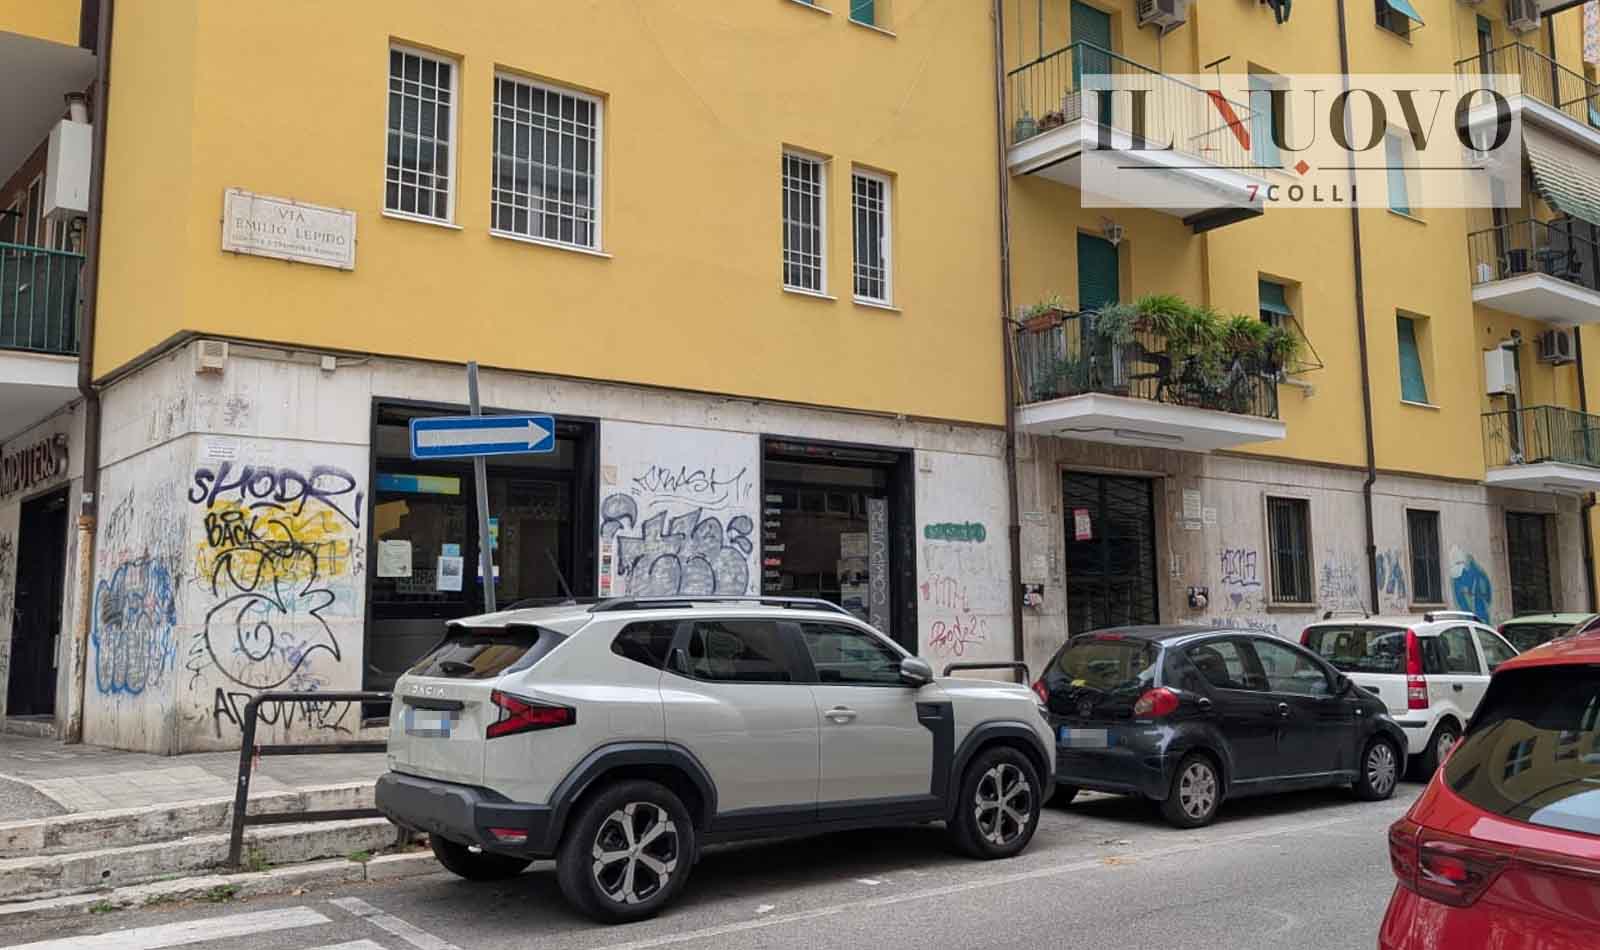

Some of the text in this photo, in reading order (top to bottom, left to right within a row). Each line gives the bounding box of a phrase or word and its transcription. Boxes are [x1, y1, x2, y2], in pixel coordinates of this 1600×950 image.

[278, 206, 305, 223] VIA
[235, 217, 287, 235] EMILIO
[295, 228, 345, 246] LEPIDO
[871, 501, 888, 605] COMPUTERS
[408, 684, 448, 698] DACIA
